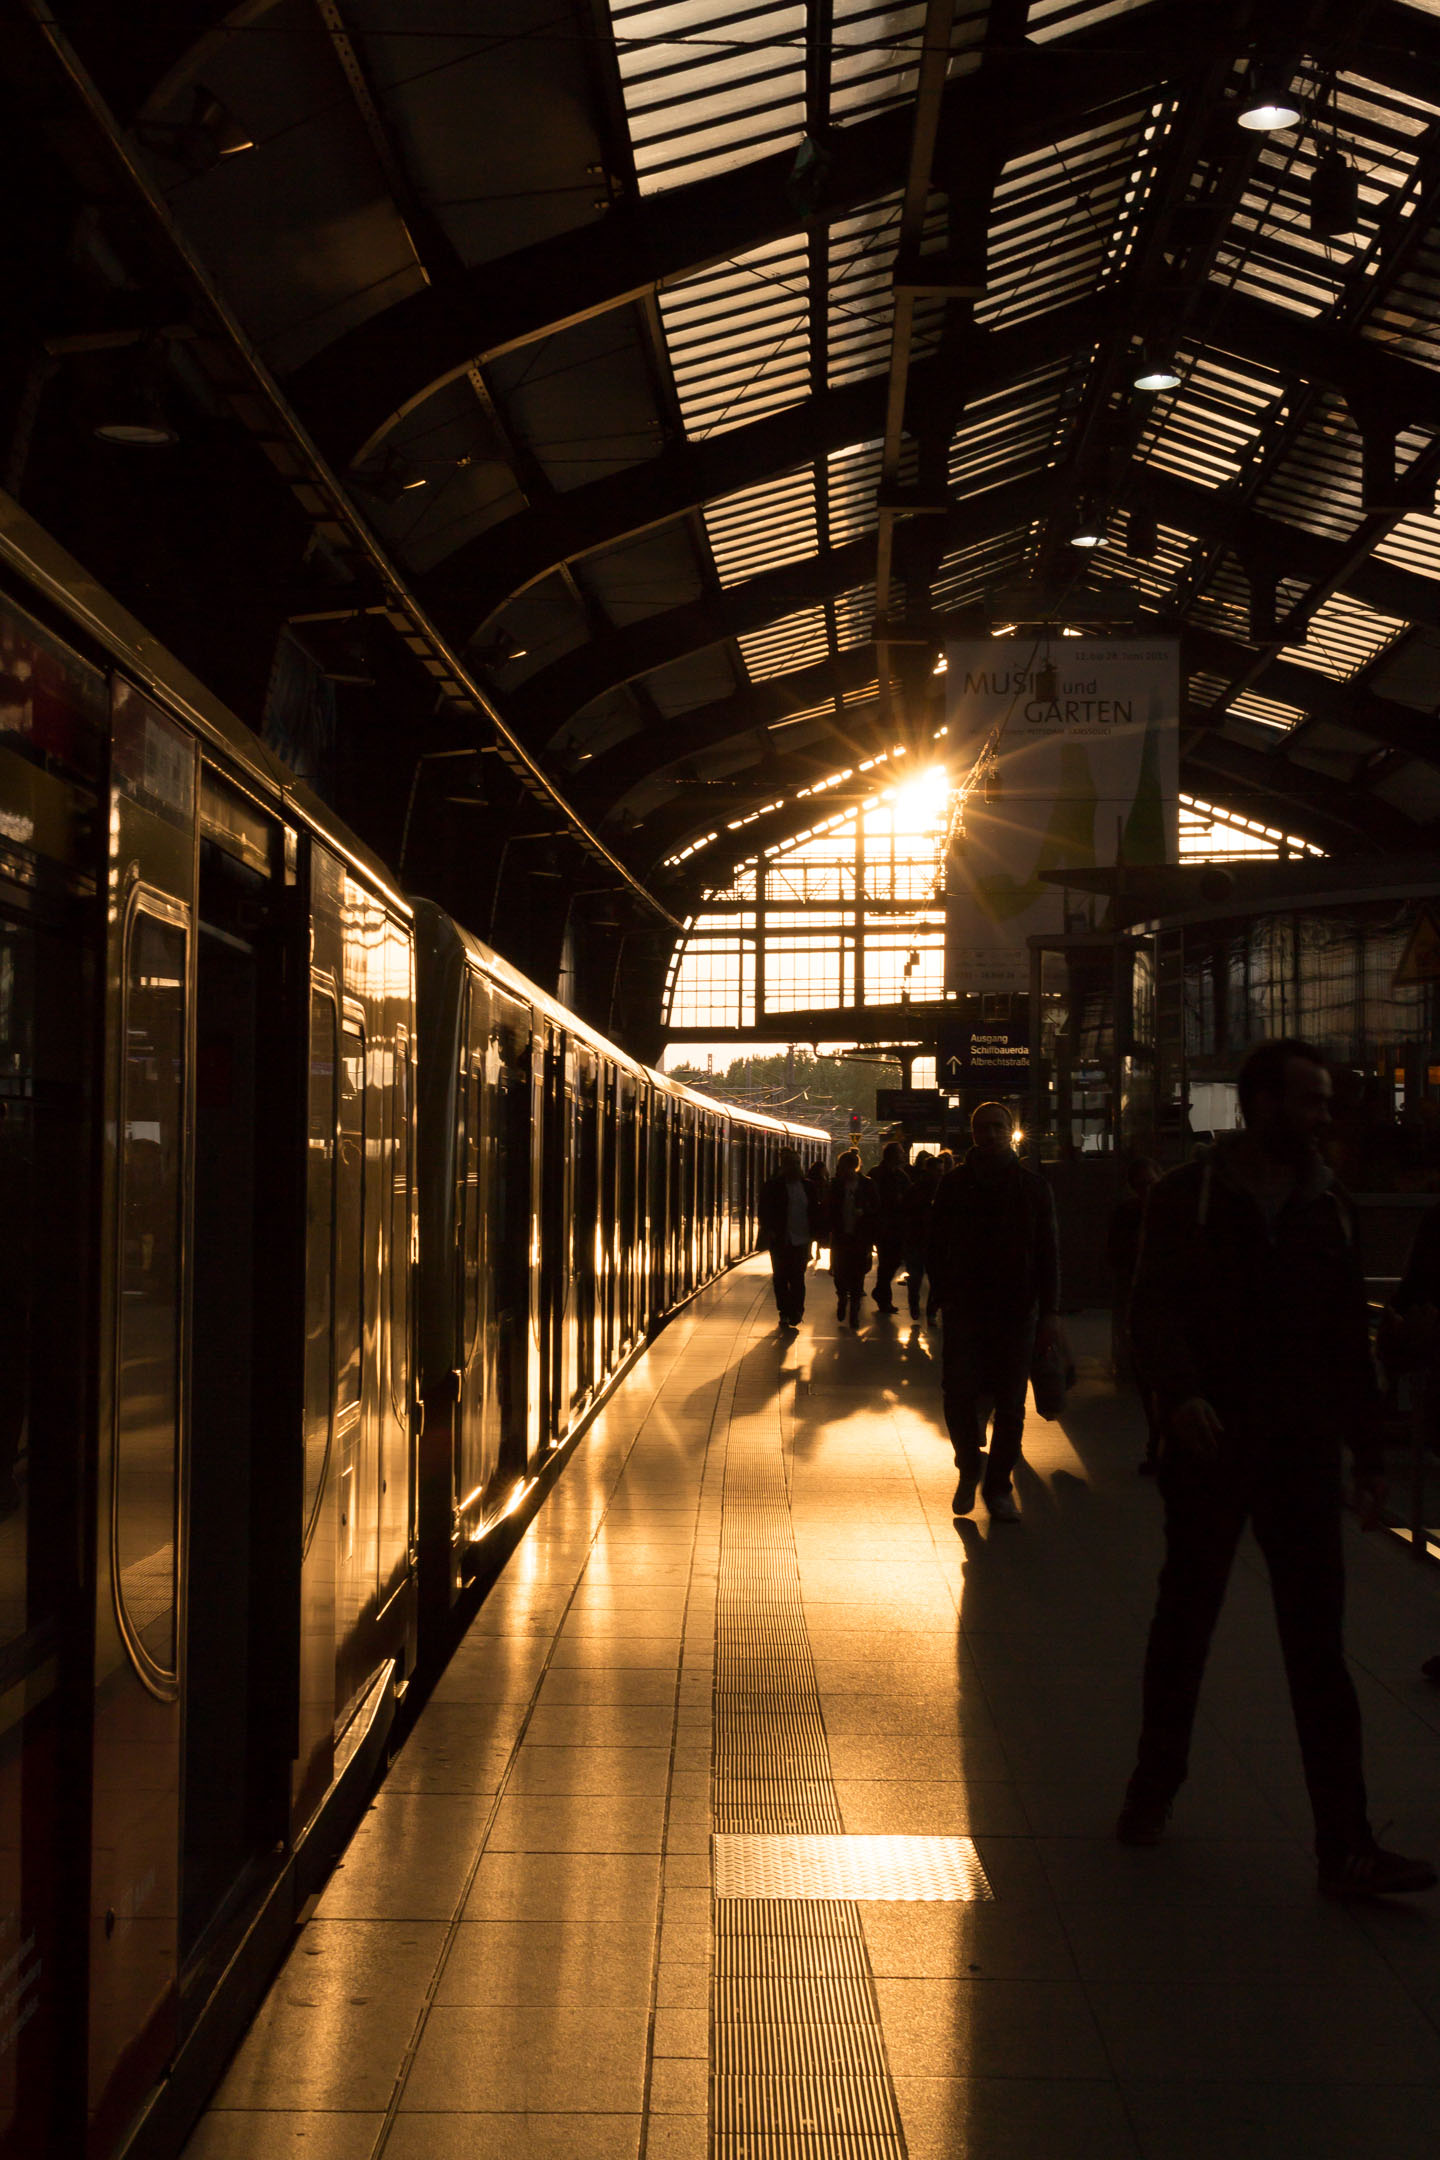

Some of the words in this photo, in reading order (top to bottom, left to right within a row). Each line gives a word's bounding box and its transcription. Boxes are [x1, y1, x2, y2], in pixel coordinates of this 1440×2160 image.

[963, 672, 1034, 695] MUSI
[1063, 679, 1097, 695] und
[969, 1033, 1009, 1045] Ausgang
[969, 1045, 1031, 1055] Schiffbauerda
